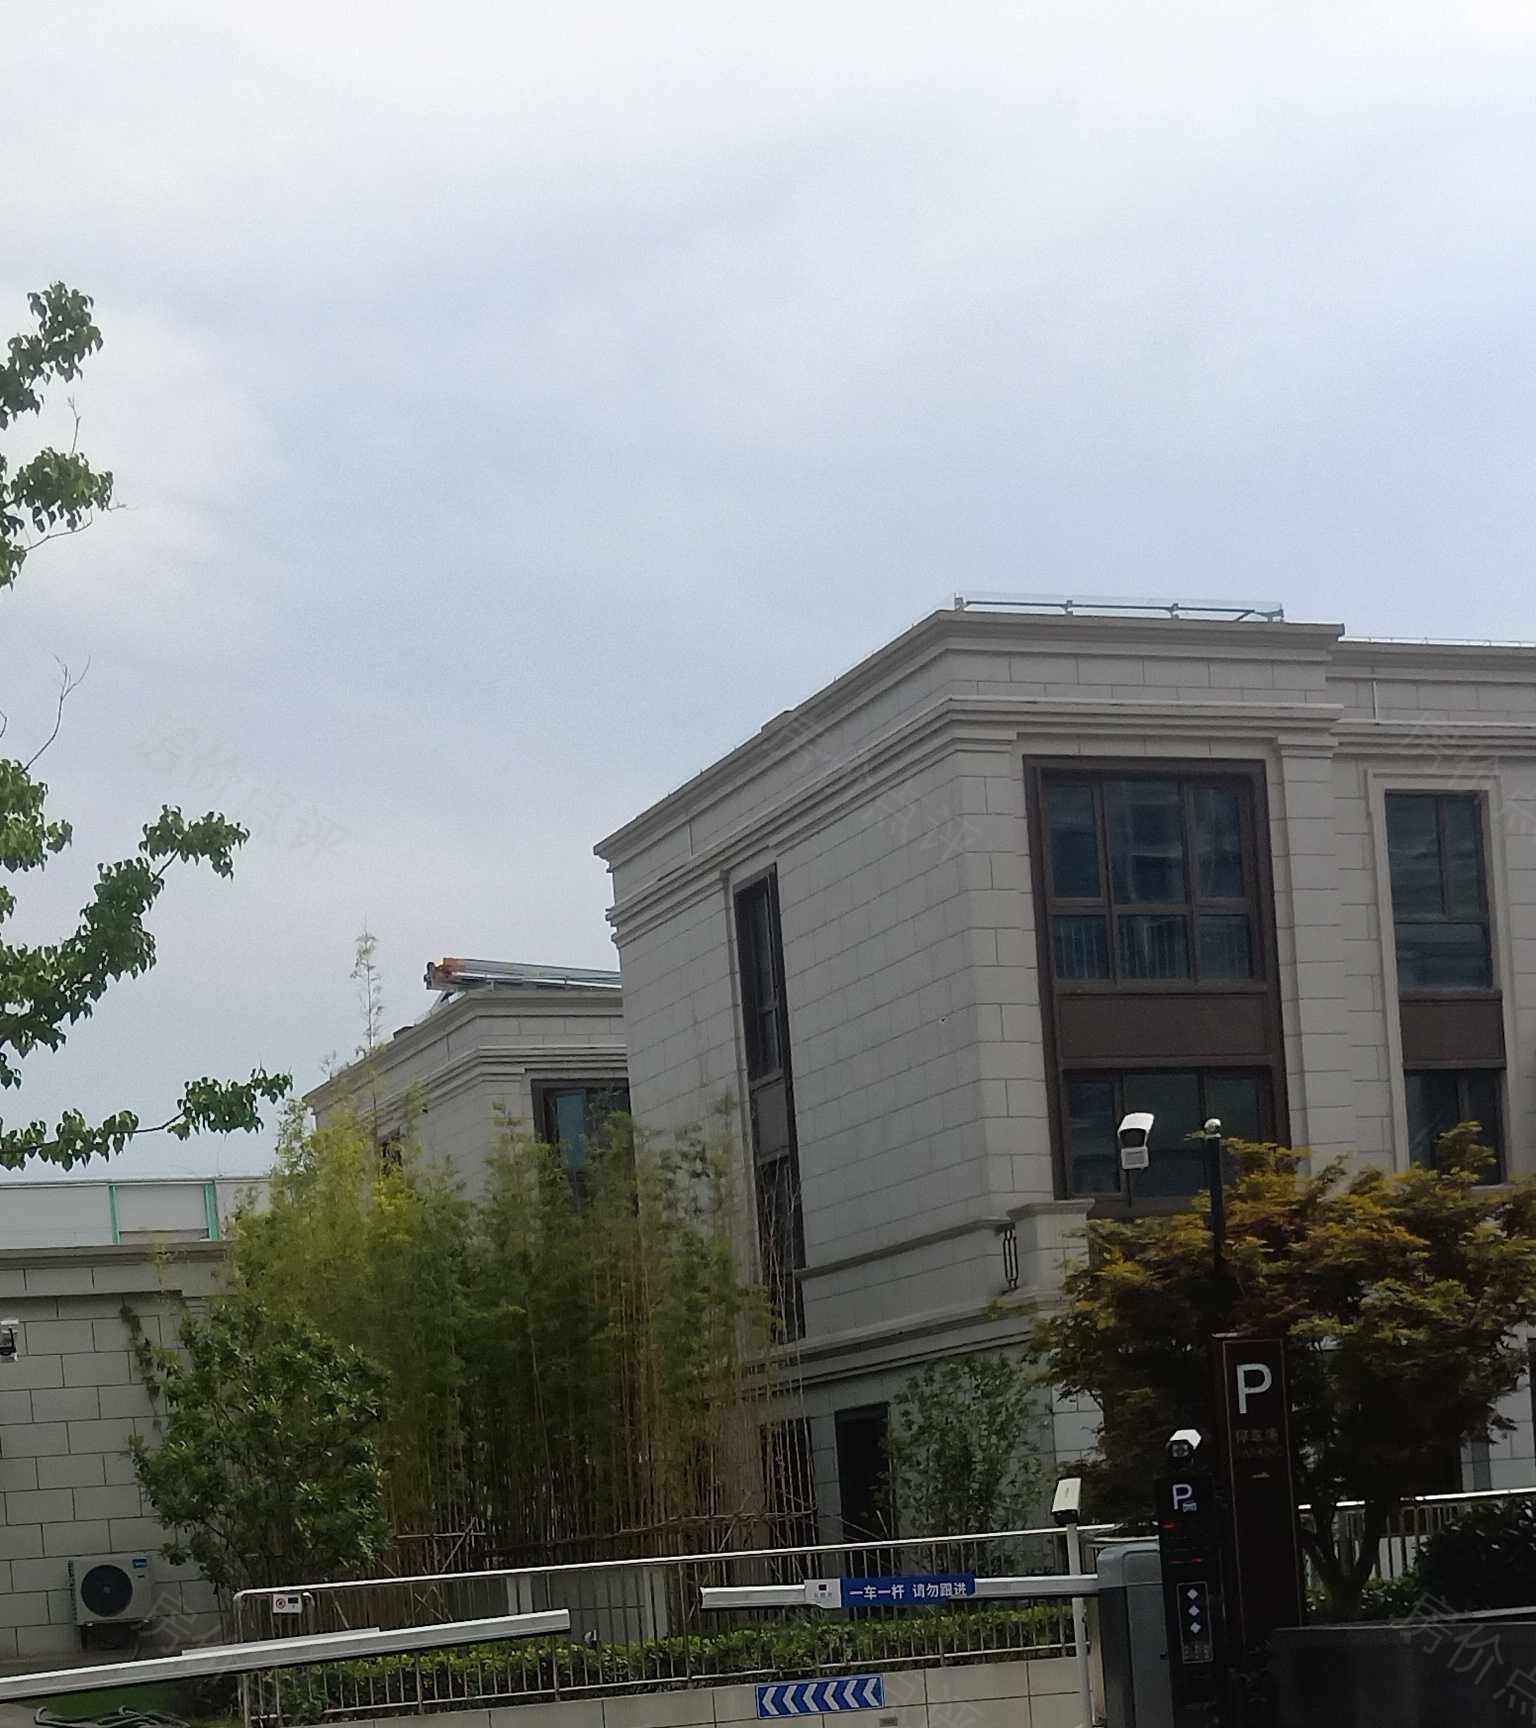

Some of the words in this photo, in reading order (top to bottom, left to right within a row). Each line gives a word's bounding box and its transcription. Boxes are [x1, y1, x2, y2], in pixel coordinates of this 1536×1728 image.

[1236, 1363, 1272, 1414] P
[1172, 1484, 1192, 1511] P
[849, 1584, 905, 1600] 一车一杆
